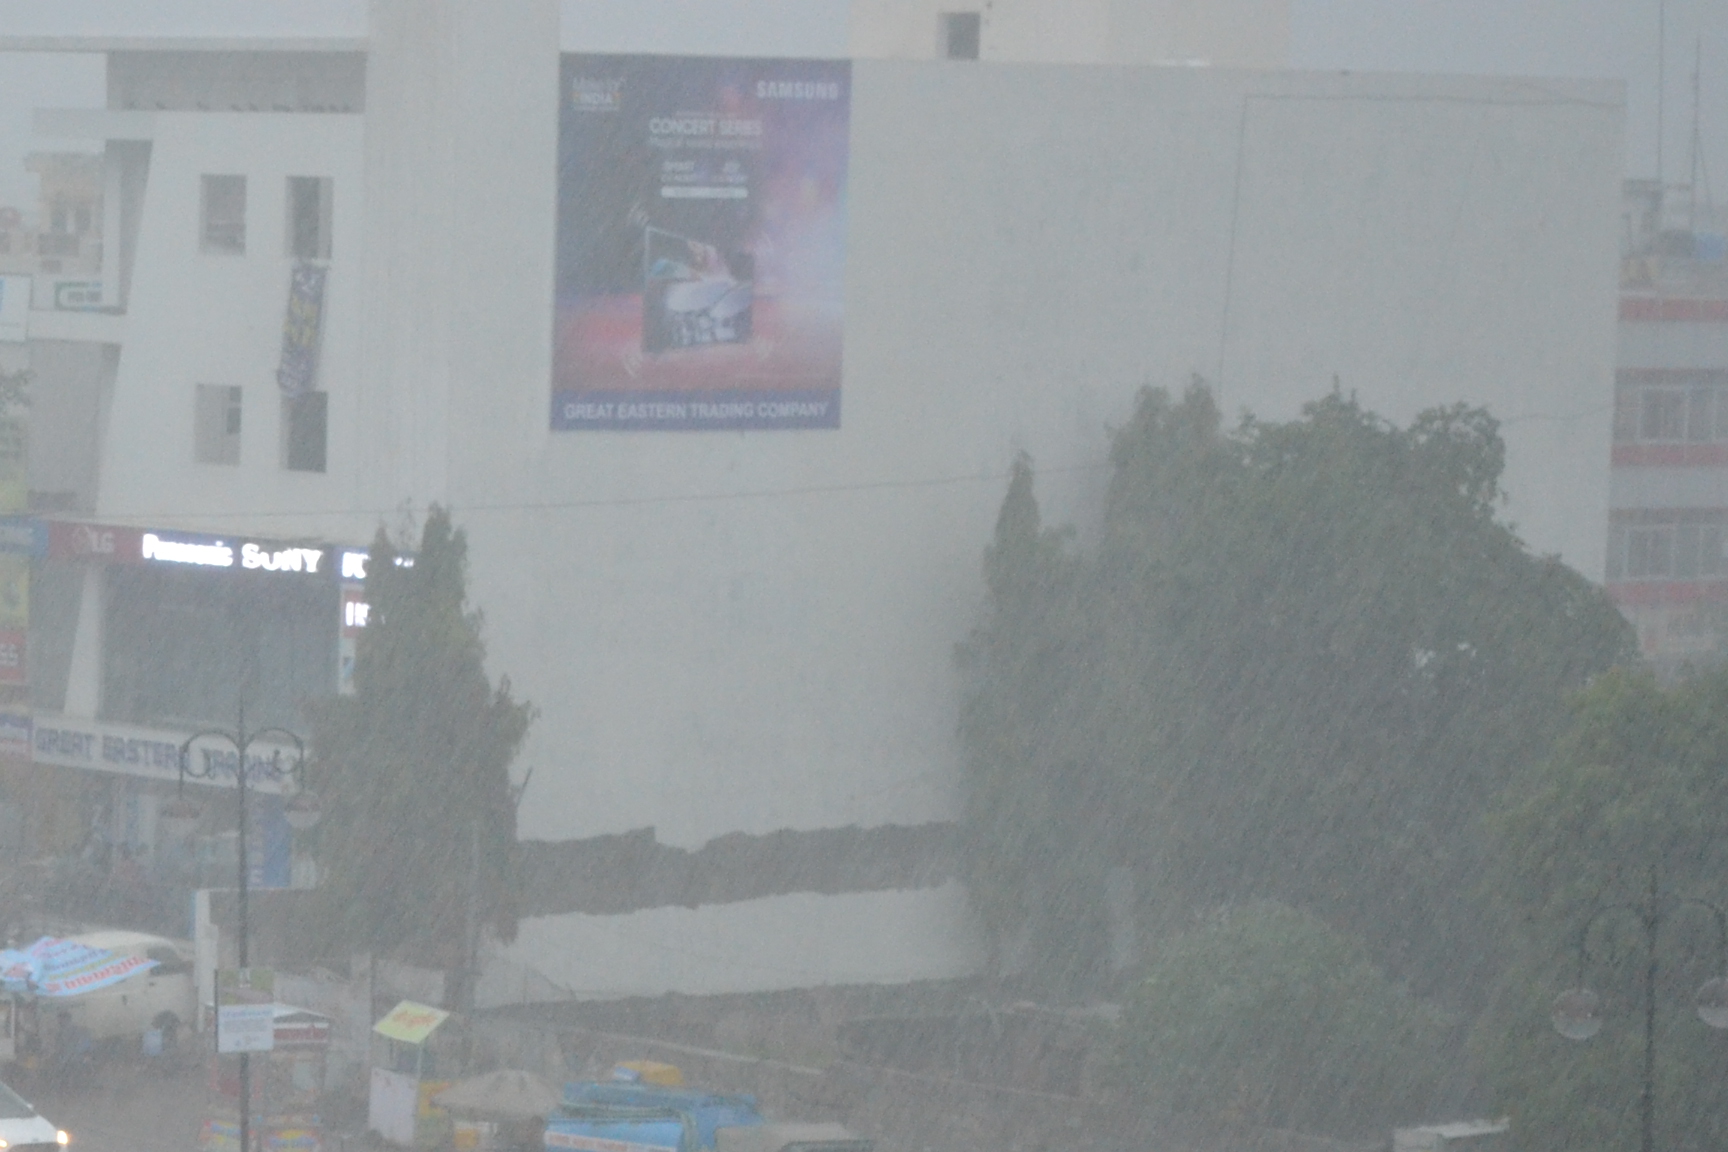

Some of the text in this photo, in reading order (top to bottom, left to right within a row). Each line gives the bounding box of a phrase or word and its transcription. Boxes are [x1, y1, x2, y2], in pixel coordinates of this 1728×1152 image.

[757, 81, 839, 100] SAMSUNG
[649, 117, 763, 135] CONCERT SERIES
[564, 401, 829, 419] GREAT EASTERN TRADING COMPANY
[91, 530, 115, 553] LG
[35, 727, 95, 761] GREAT
